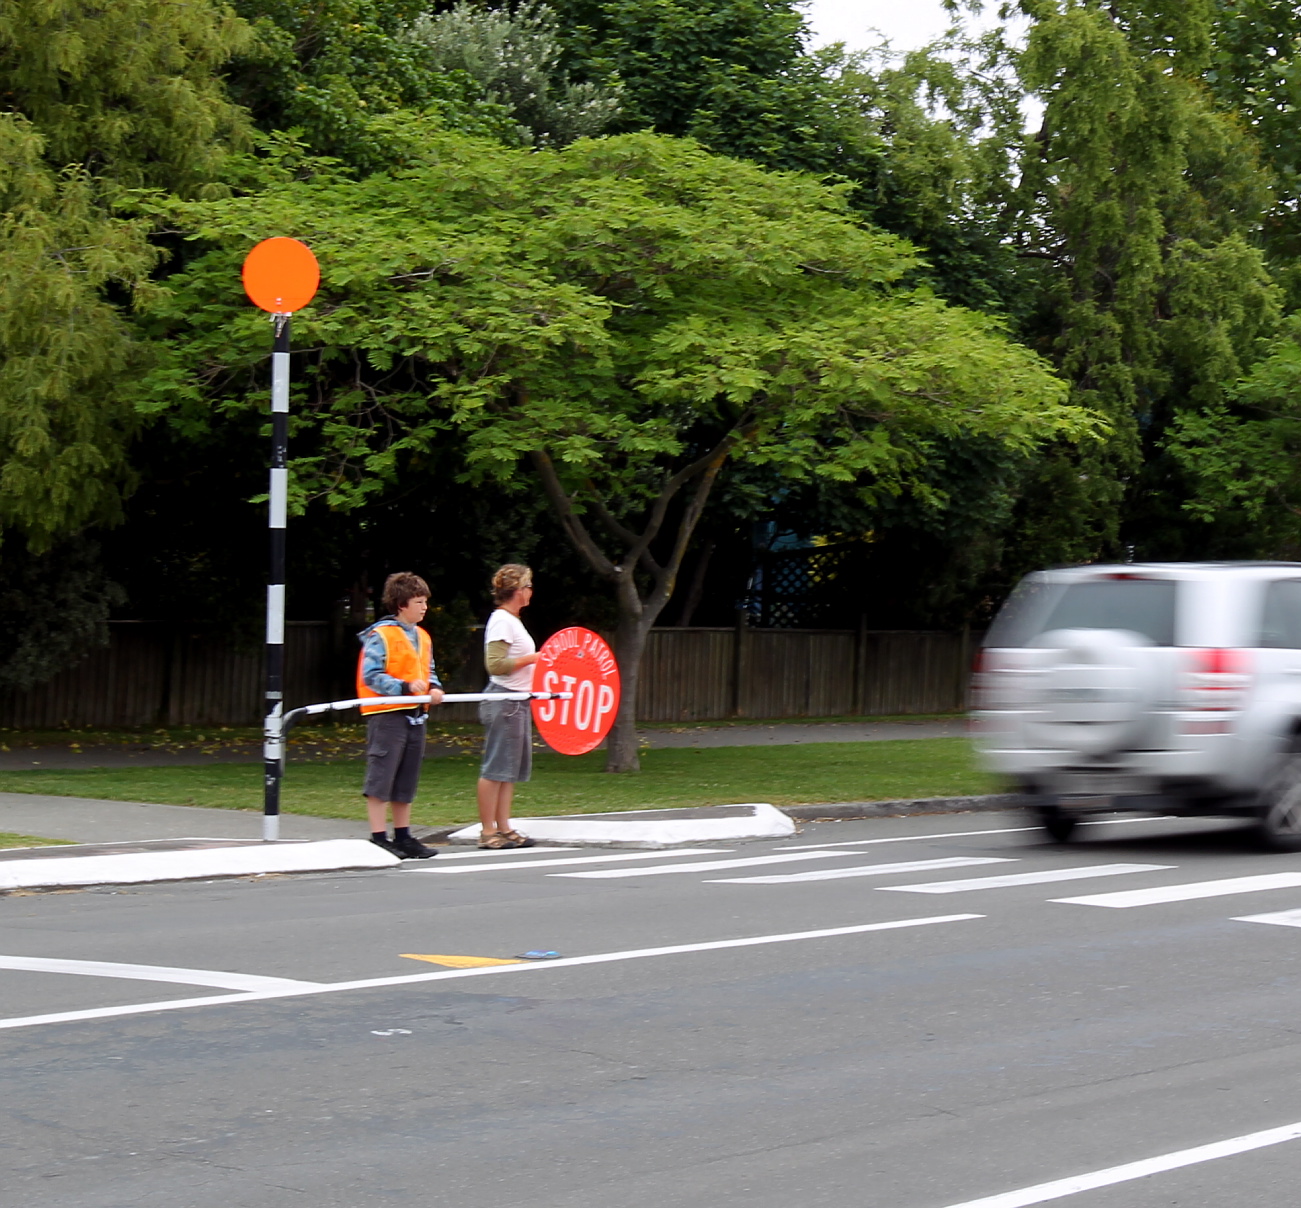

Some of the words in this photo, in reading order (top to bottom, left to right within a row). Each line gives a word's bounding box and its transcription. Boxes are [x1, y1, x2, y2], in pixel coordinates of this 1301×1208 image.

[541, 630, 580, 667] SCHOOL
[582, 633, 617, 680] PATROL
[538, 670, 615, 733] STOP
